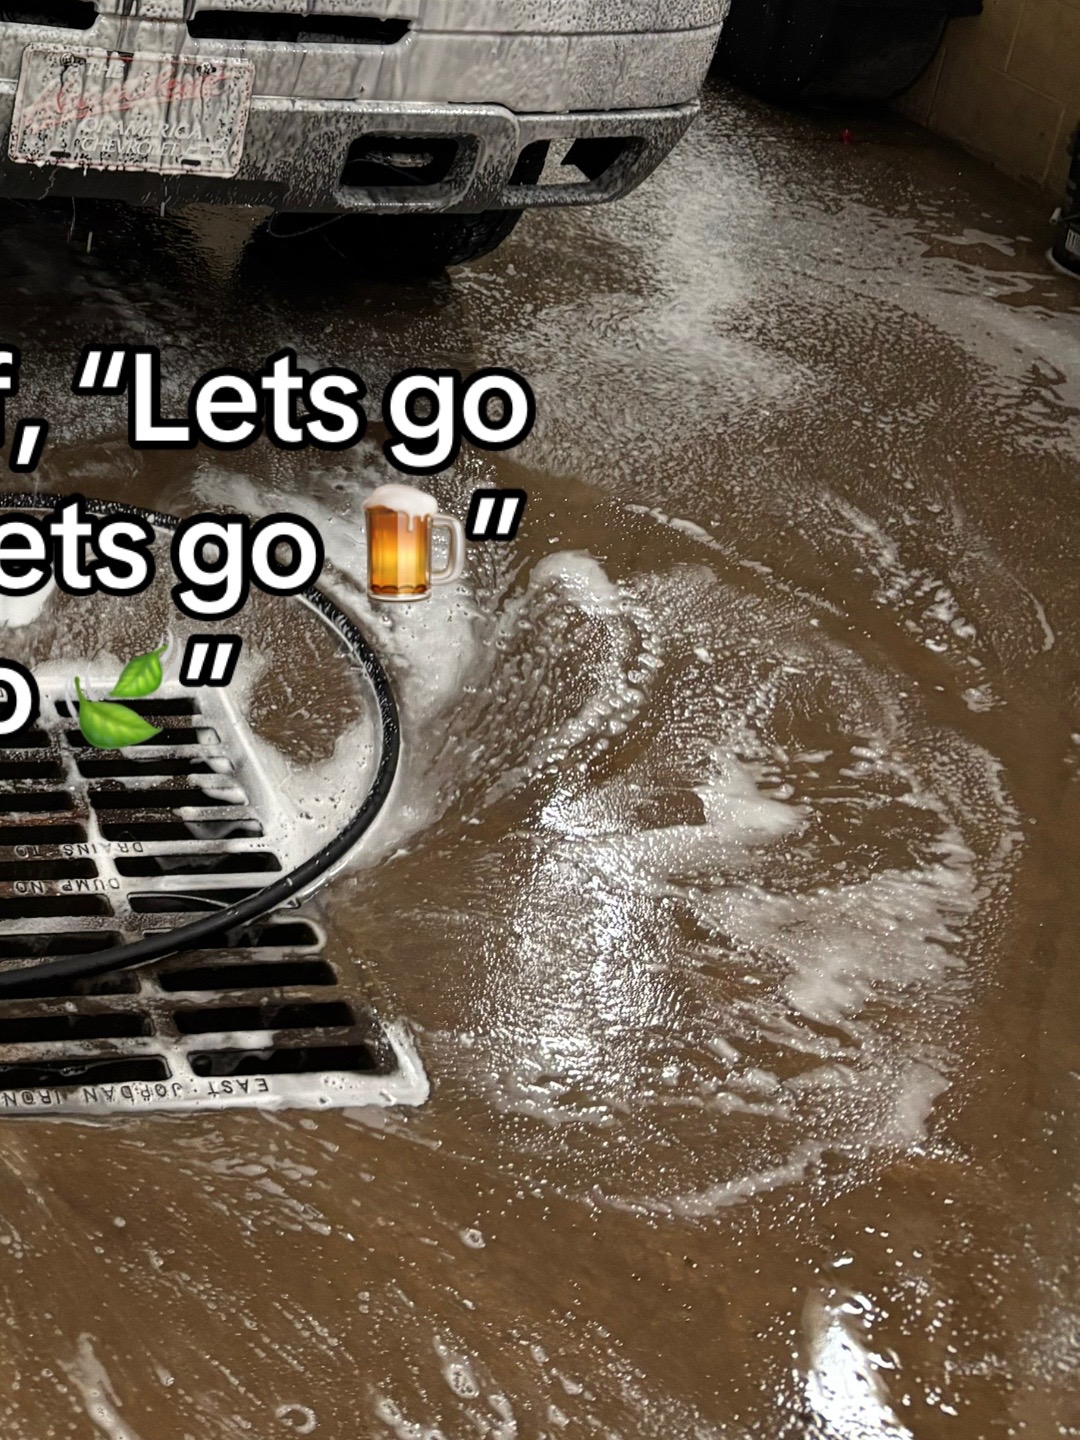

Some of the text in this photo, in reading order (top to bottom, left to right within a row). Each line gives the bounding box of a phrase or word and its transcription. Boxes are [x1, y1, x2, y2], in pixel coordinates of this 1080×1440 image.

[15, 844, 40, 858] TO
[62, 841, 144, 857] DRAINS
[15, 880, 44, 894] NO
[61, 877, 120, 892] DUMP
[82, 1082, 183, 1104] JORDAN
[206, 1077, 270, 1096] EAST
[3, 1090, 61, 1106] IRON
